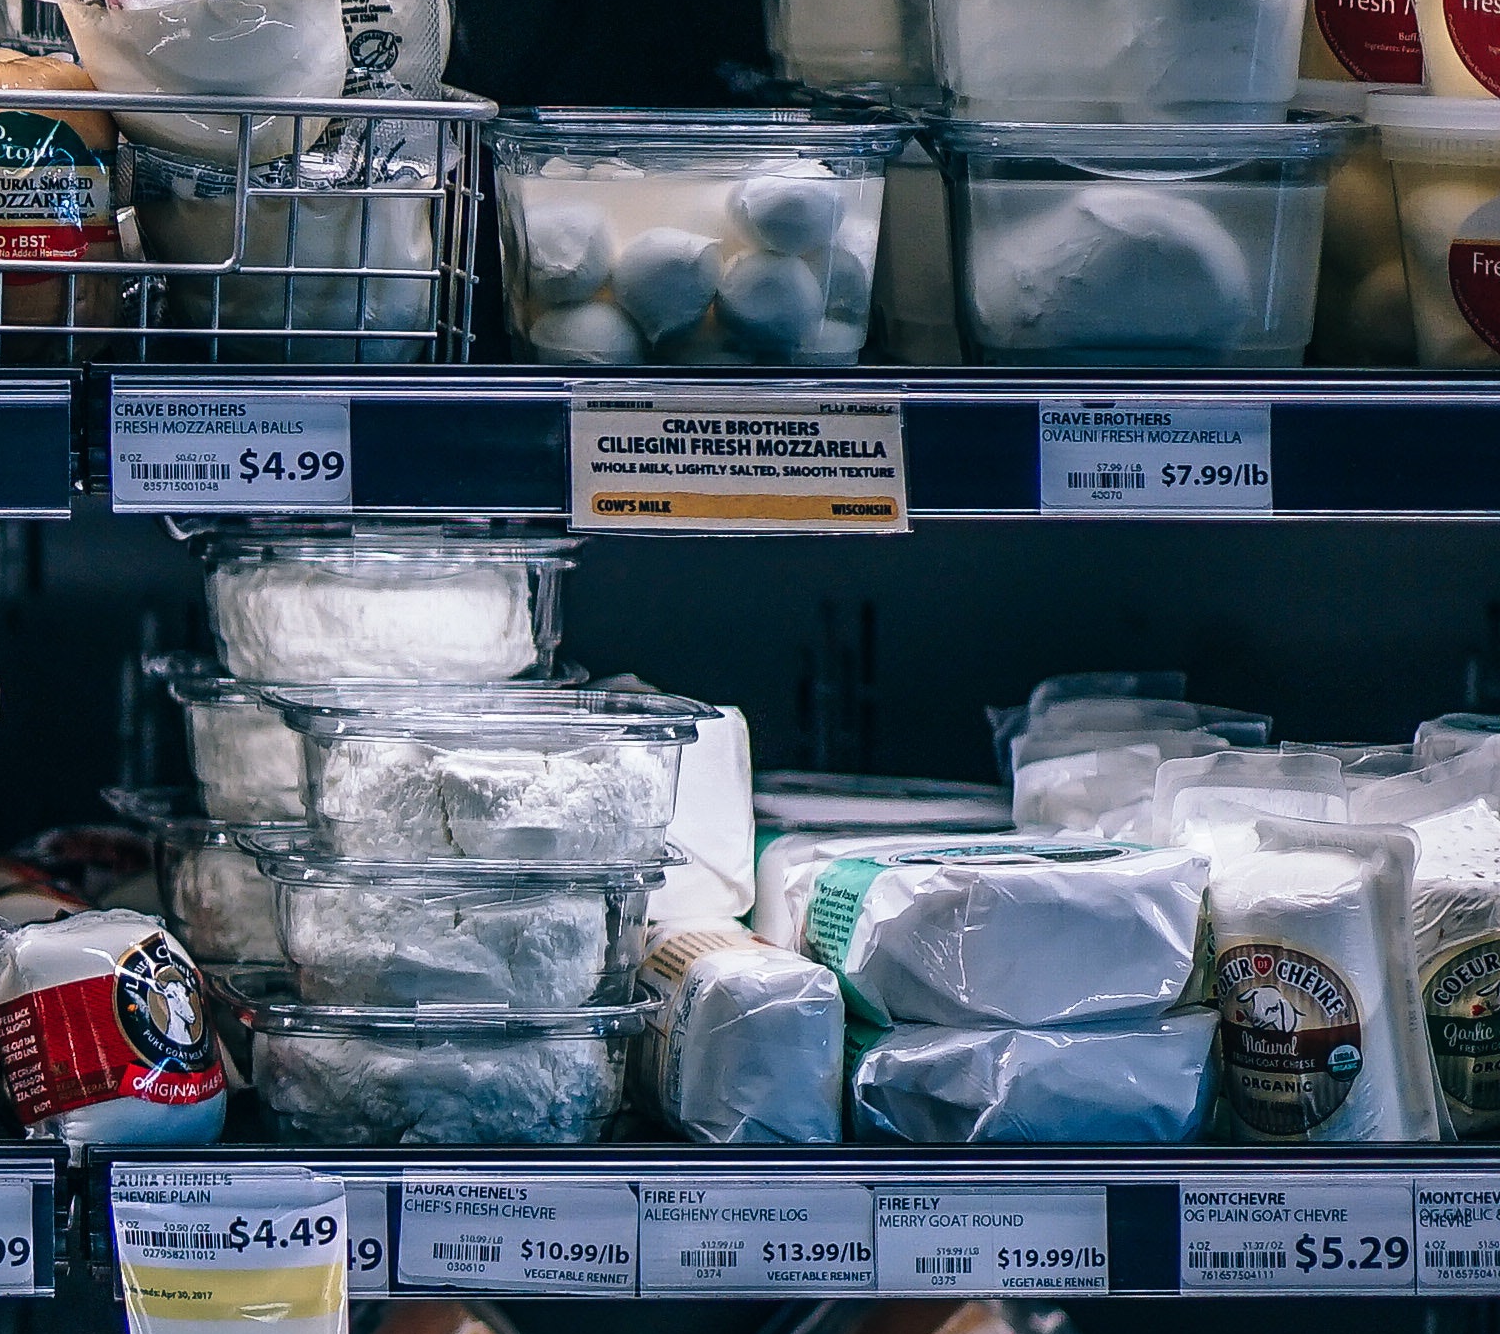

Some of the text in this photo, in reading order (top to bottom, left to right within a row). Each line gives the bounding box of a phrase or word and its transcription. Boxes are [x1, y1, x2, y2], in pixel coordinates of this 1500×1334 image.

[597, 436, 888, 459] CILIEGINI FRESH MOZZARELLA
[239, 447, 345, 485] $4.99
[878, 1197, 941, 1211] FIRE FLY
[876, 1214, 1024, 1228] MERRY GOAT ROUND
[997, 1247, 1106, 1270] $19.99/lb
